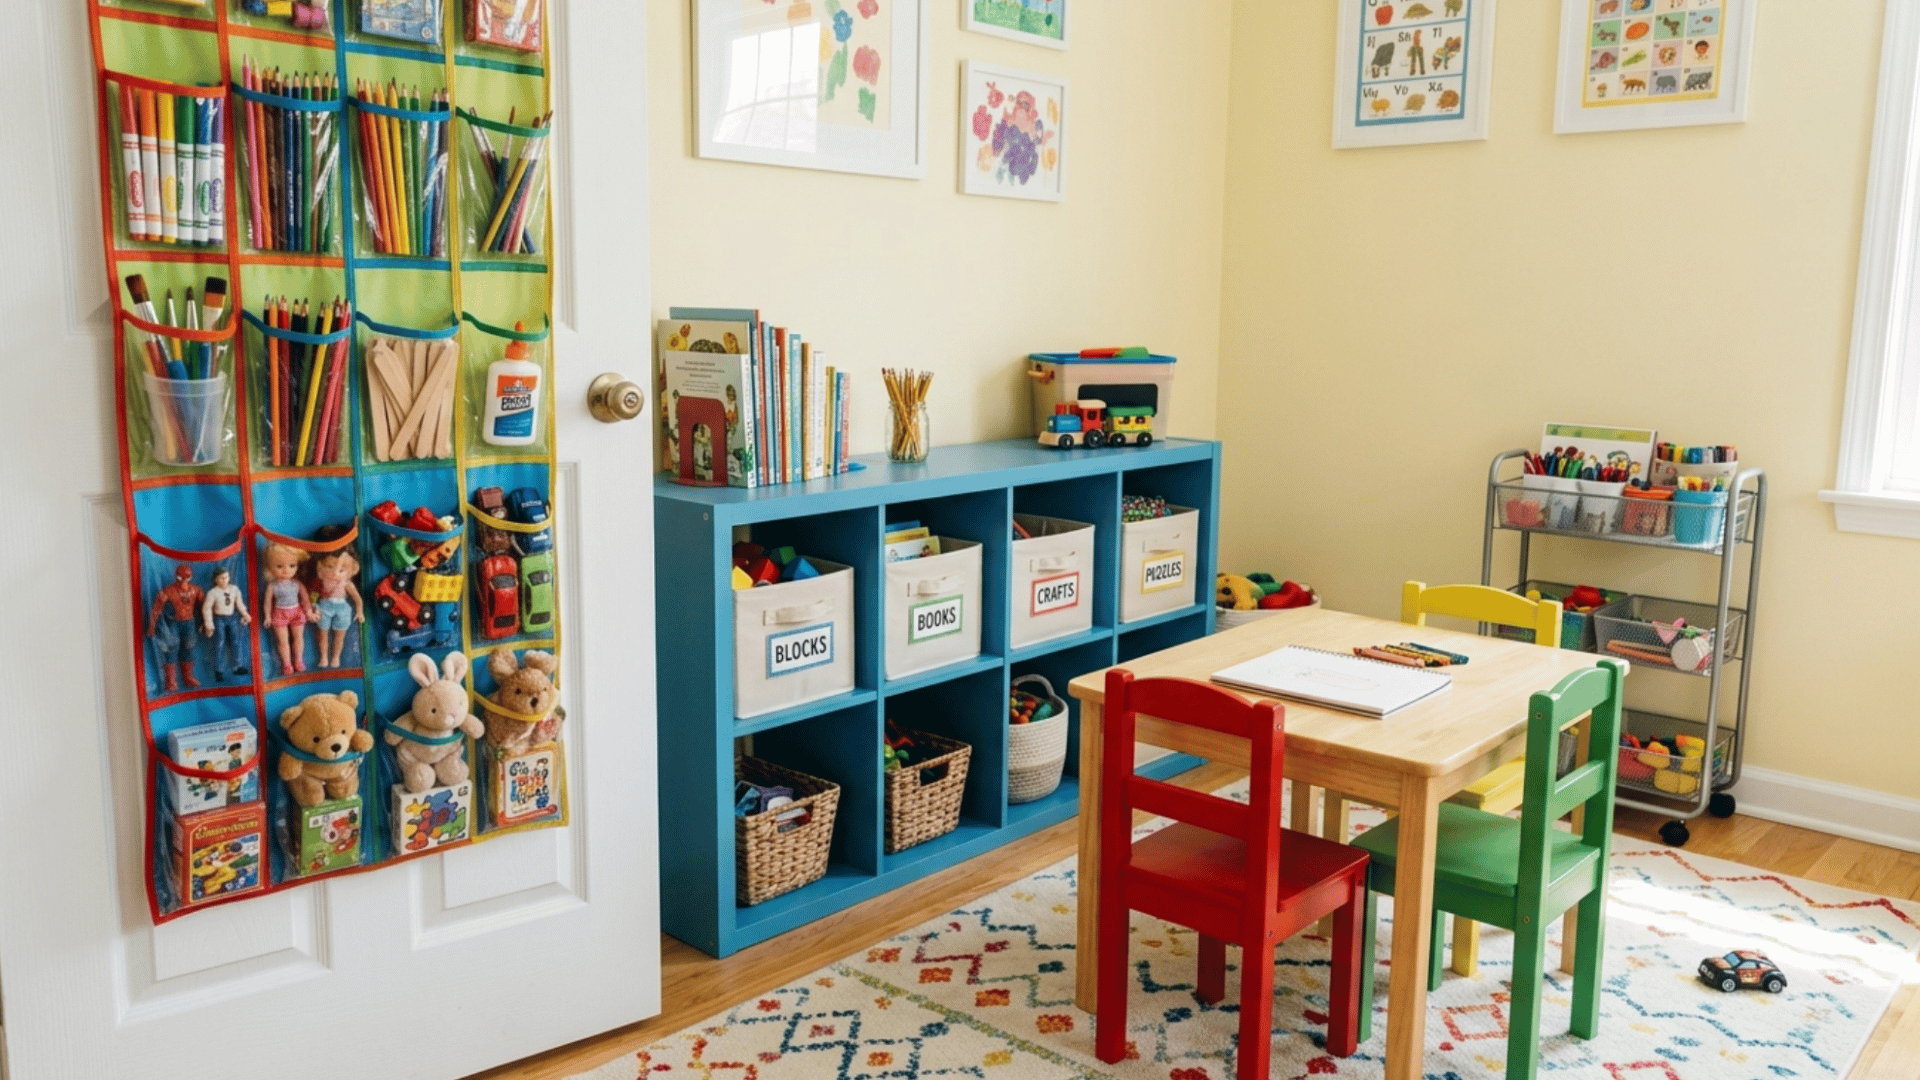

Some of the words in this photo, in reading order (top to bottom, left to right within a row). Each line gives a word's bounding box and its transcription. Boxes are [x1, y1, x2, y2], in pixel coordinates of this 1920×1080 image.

[1037, 582, 1075, 605] CRAFTS
[917, 606, 956, 631] BOOKS
[775, 635, 827, 664] BLOCKS
